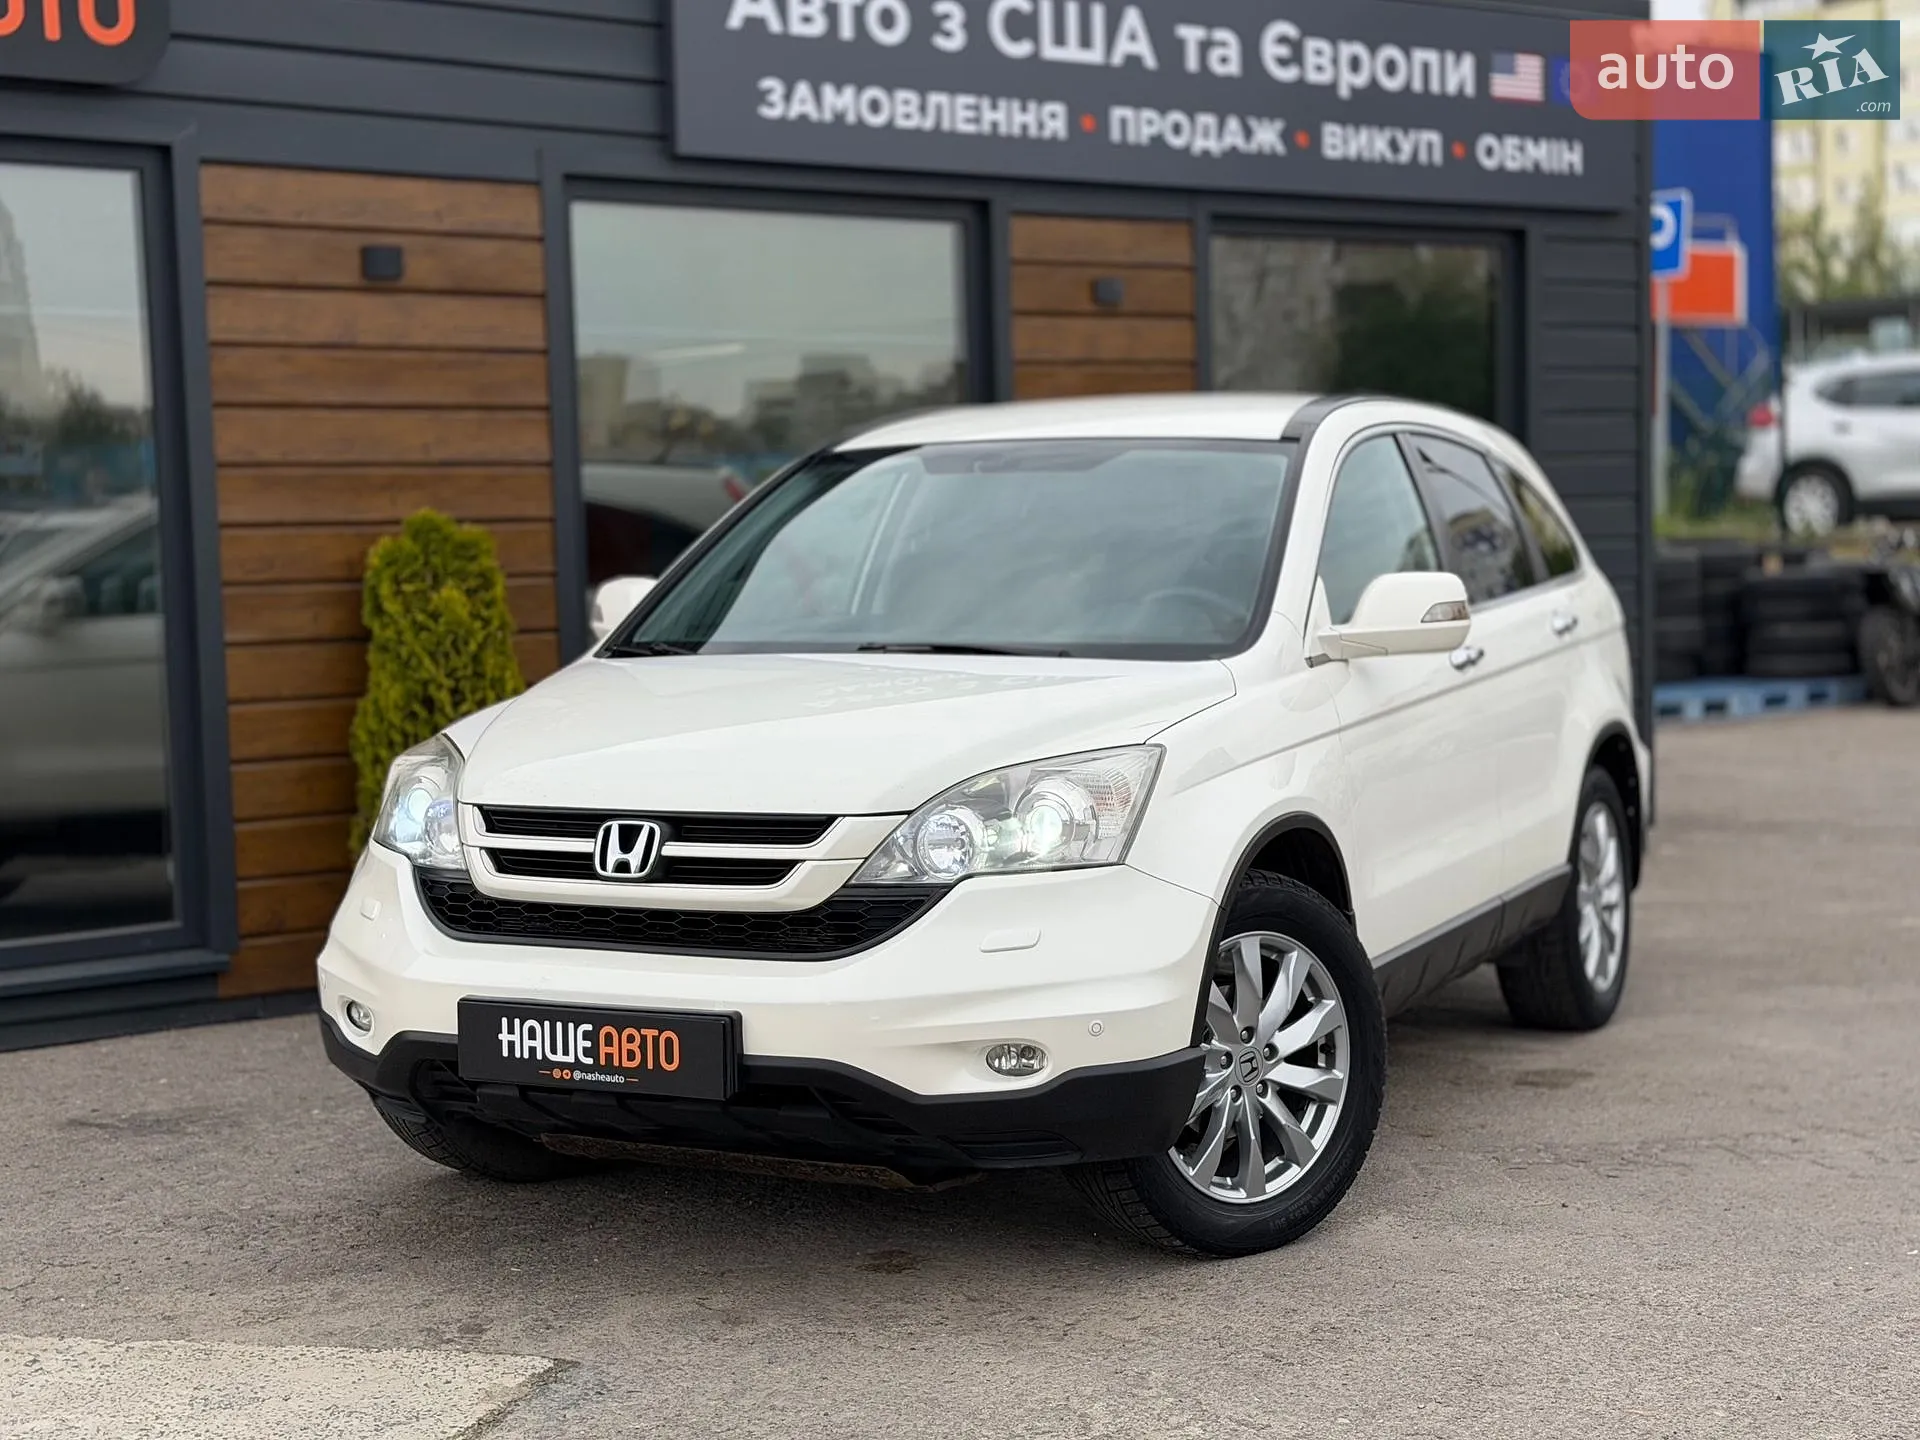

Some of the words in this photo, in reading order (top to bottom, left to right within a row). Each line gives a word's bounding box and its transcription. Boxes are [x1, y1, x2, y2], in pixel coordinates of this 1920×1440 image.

[931, 1, 968, 53] з
[987, 0, 1159, 71] США
[1173, 23, 1242, 77] та
[1259, 19, 1477, 100] Європи
[757, 77, 1068, 140] ЗАМОВЛЕННЯ
[1108, 104, 1287, 158] ПРОДАЖ
[1320, 121, 1443, 168] ВИКУП
[1475, 132, 1584, 176] ОБМІН
[572, 1069, 625, 1083] @nasheauto
